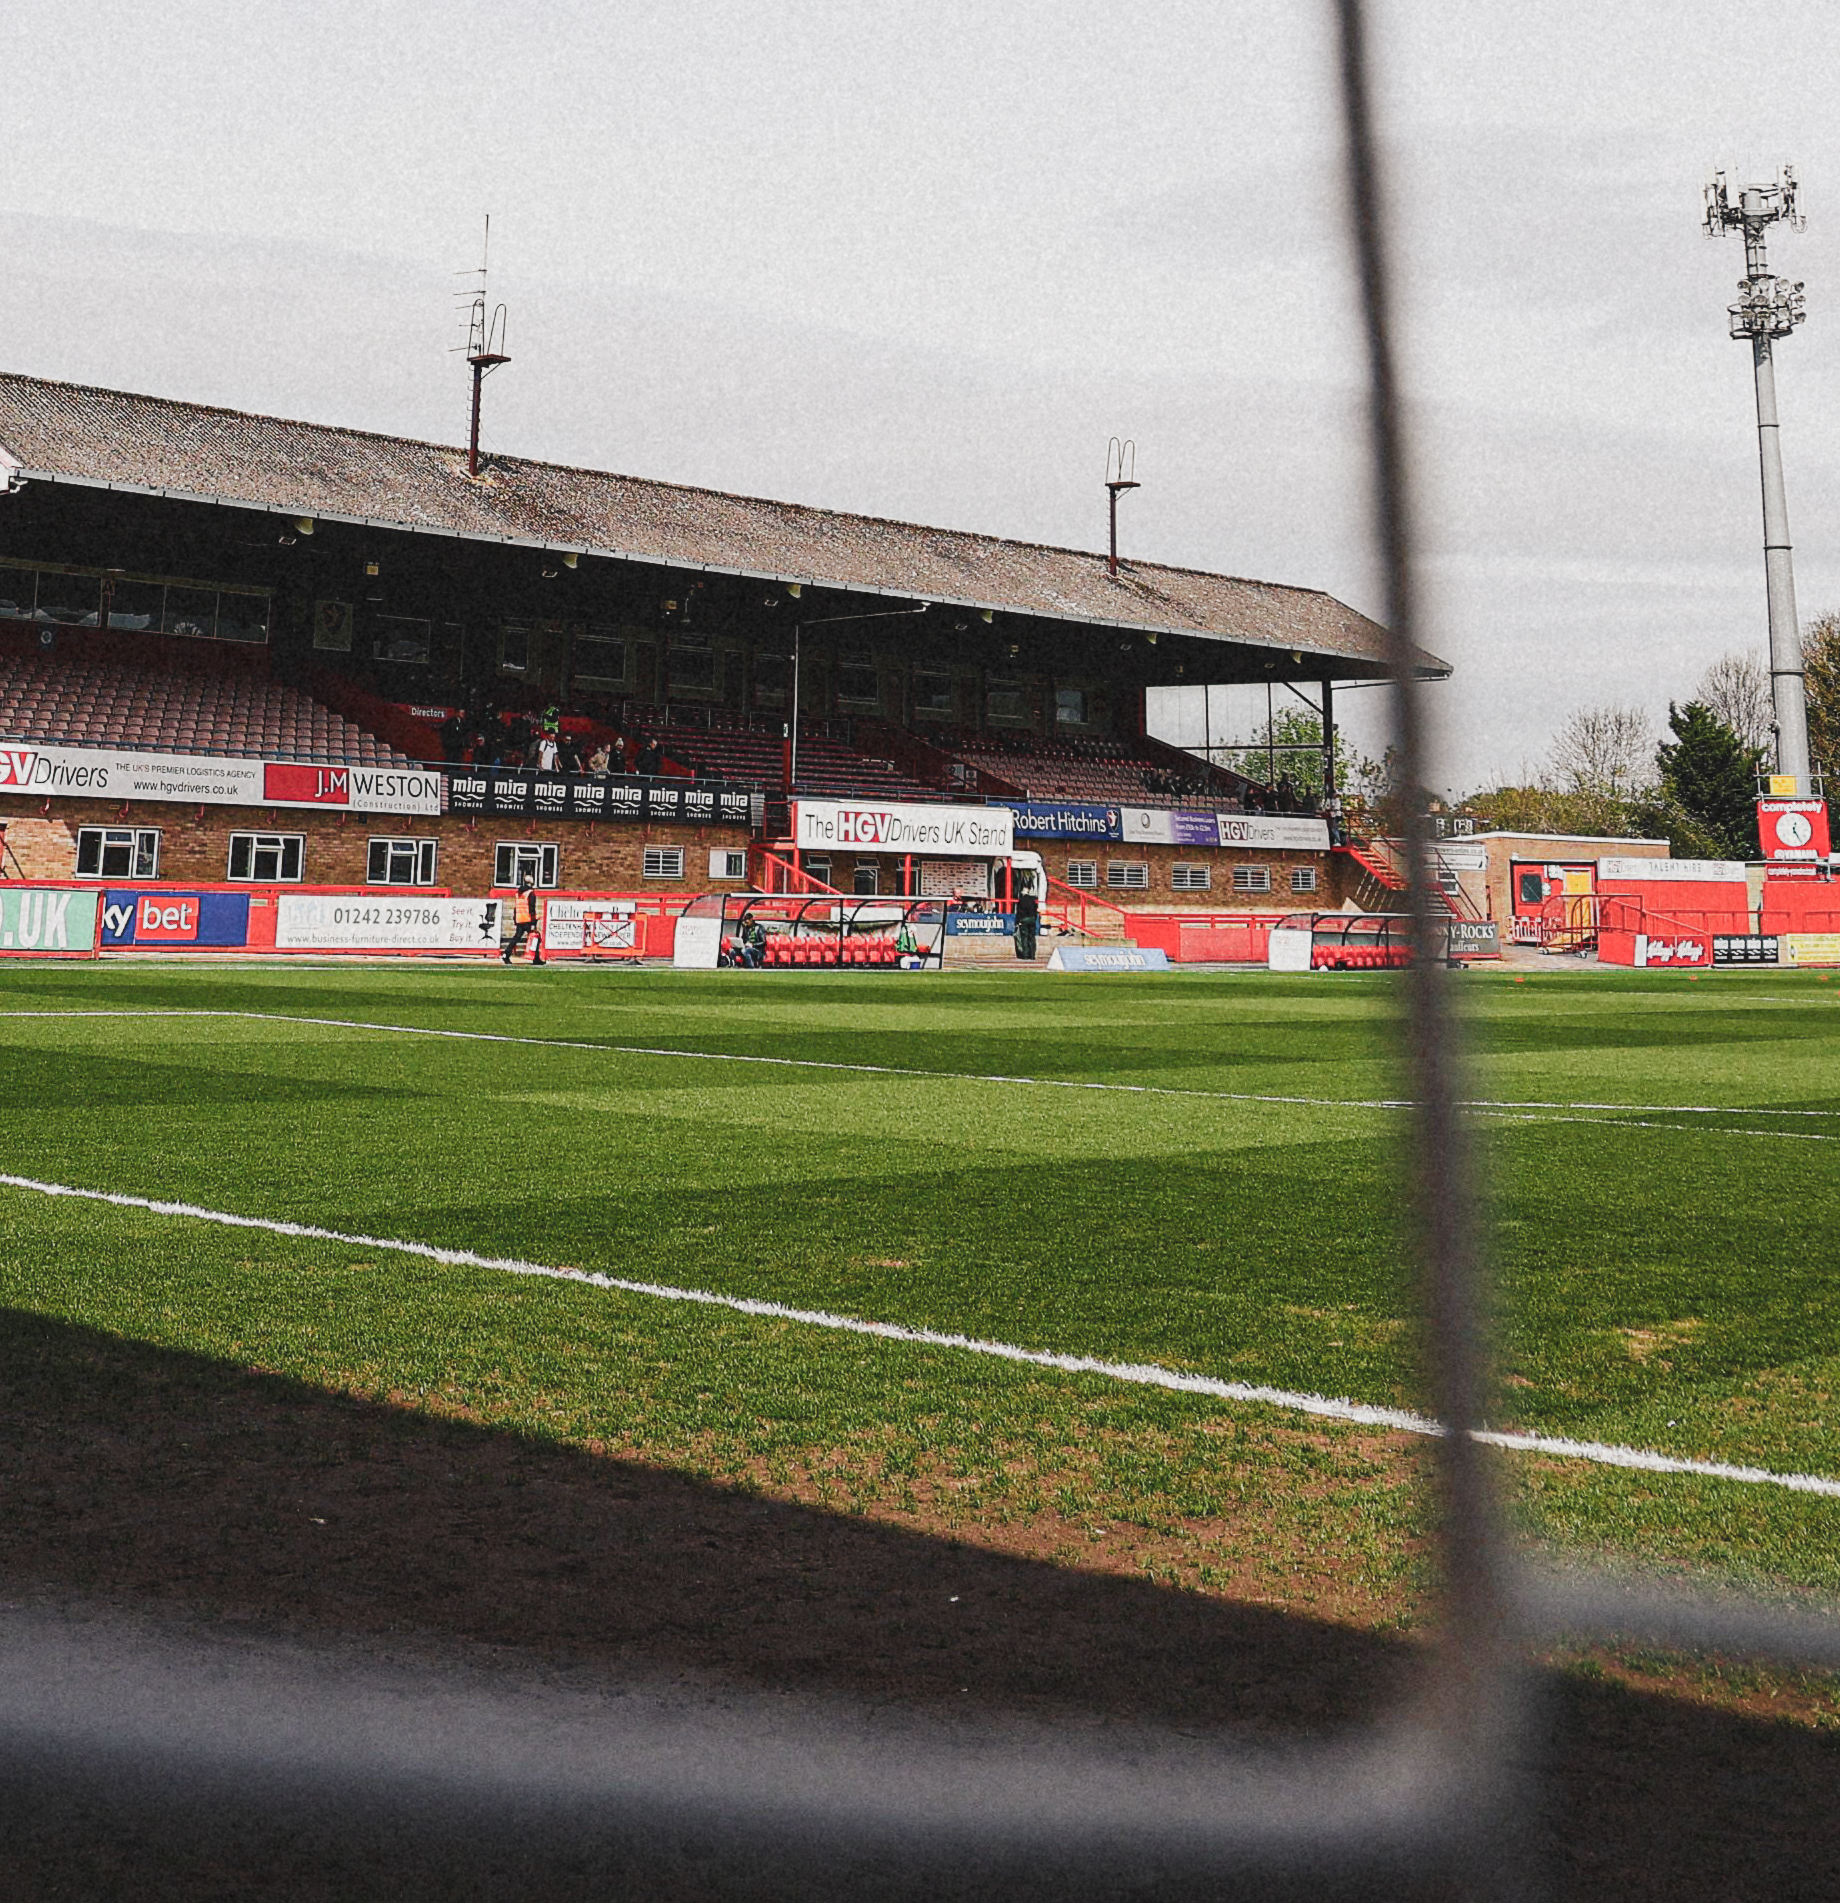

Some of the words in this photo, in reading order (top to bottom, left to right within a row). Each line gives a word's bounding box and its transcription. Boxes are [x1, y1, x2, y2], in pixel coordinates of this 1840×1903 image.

[411, 707, 445, 718] Directors
[34, 757, 109, 788] Drivers
[115, 762, 131, 772] THE
[132, 763, 150, 774] UK'S
[151, 764, 185, 776] PREMIER
[186, 766, 225, 778] LOGISTICS
[226, 768, 256, 780] AGENCY
[133, 780, 239, 795] www.hgvdrivers.co.uk
[314, 769, 347, 797] J.M
[353, 772, 438, 799] WESTON
[452, 777, 487, 793] mira
[494, 779, 527, 795] mira
[534, 781, 566, 797] mira
[573, 783, 605, 799] mira
[611, 785, 642, 801] mira
[648, 787, 678, 803] mira
[685, 789, 714, 804] mira
[720, 791, 748, 806] mira
[353, 799, 421, 812] (Construction)
[805, 813, 834, 839] The
[837, 811, 893, 843] HGV
[891, 819, 940, 844] Drivers
[944, 823, 965, 845] UK
[968, 821, 1007, 847] Stand
[1012, 809, 1055, 831] Robert
[1057, 809, 1107, 834] Hitchins
[101, 897, 134, 937] ky
[142, 899, 193, 930] bet
[334, 908, 380, 925] 01242
[385, 908, 440, 925] 239786
[452, 919, 464, 930] Try
[287, 933, 439, 945] www.business-furniture-direct.co.uk
